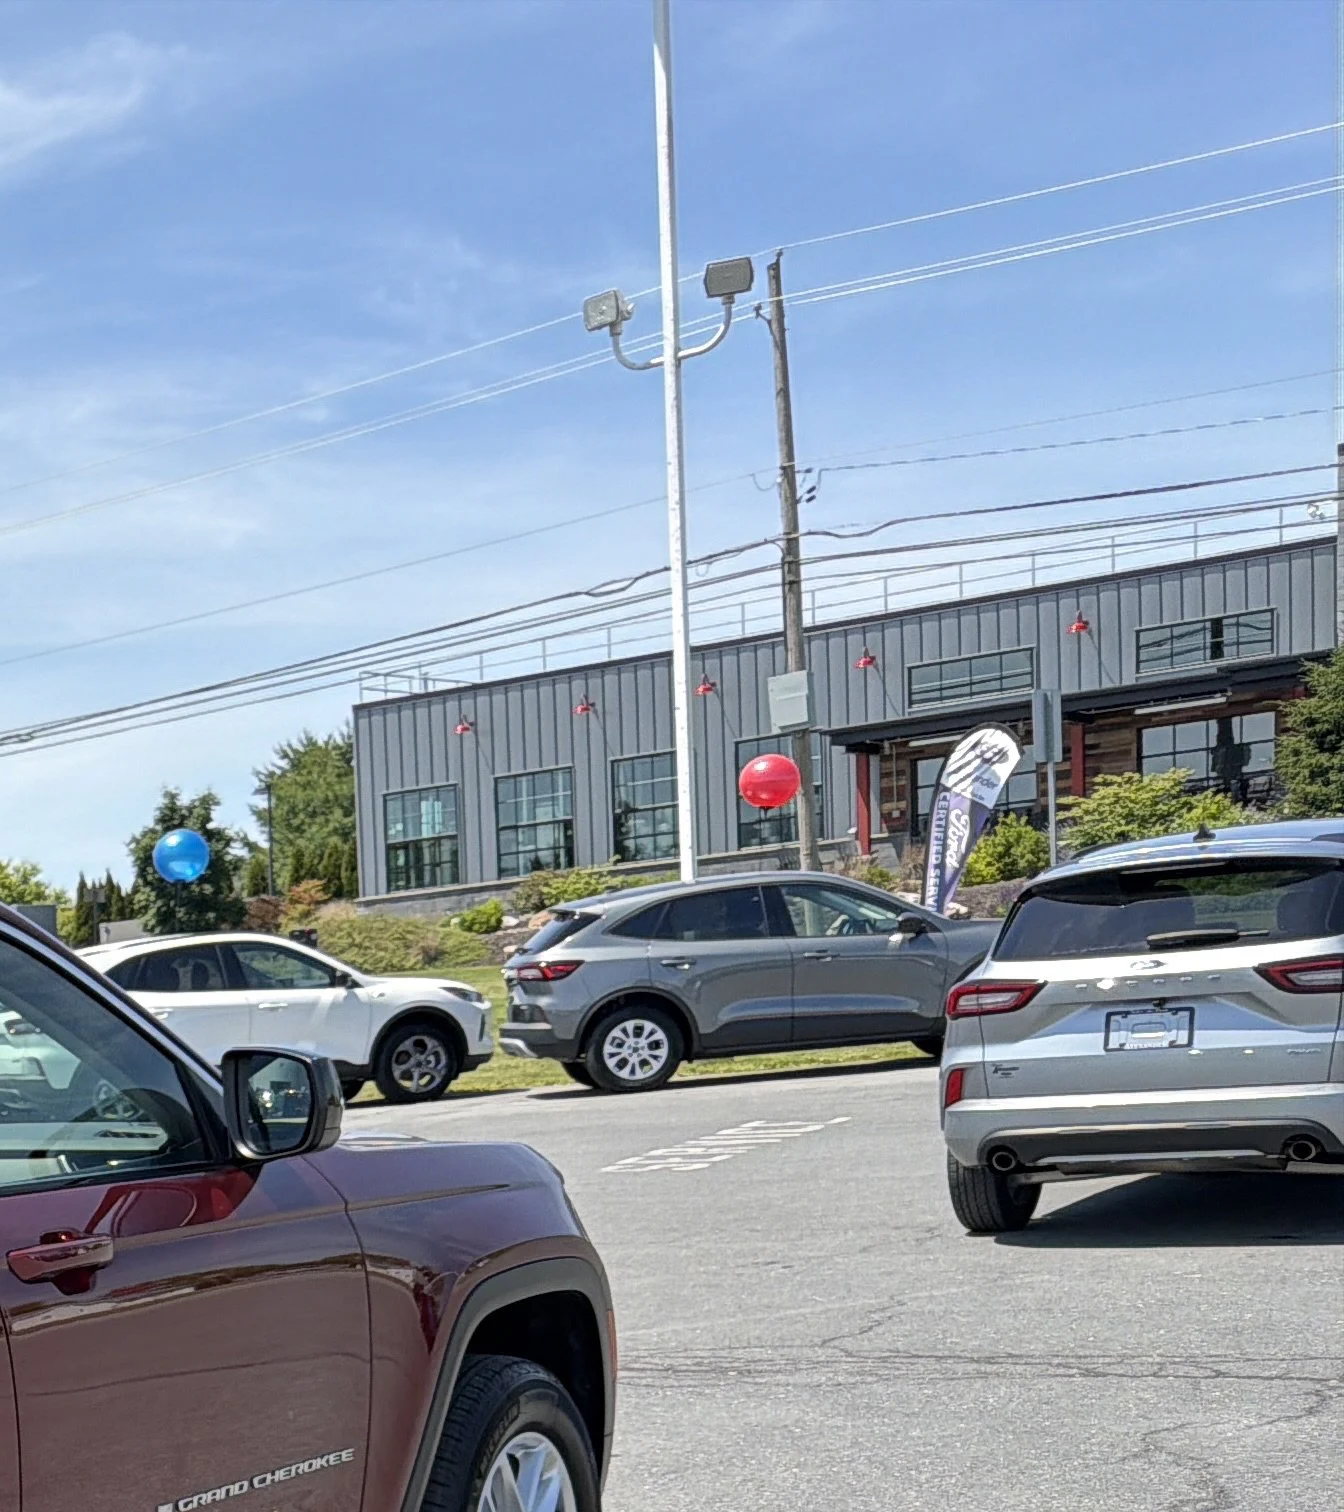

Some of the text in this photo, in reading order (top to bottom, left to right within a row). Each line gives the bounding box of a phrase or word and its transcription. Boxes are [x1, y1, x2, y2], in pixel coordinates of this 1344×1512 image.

[931, 791, 951, 865] CERTIFIED
[945, 808, 971, 869] Ford
[599, 1115, 853, 1173] SERVICE
[177, 1448, 355, 1512] GRAND CHEROKEE
